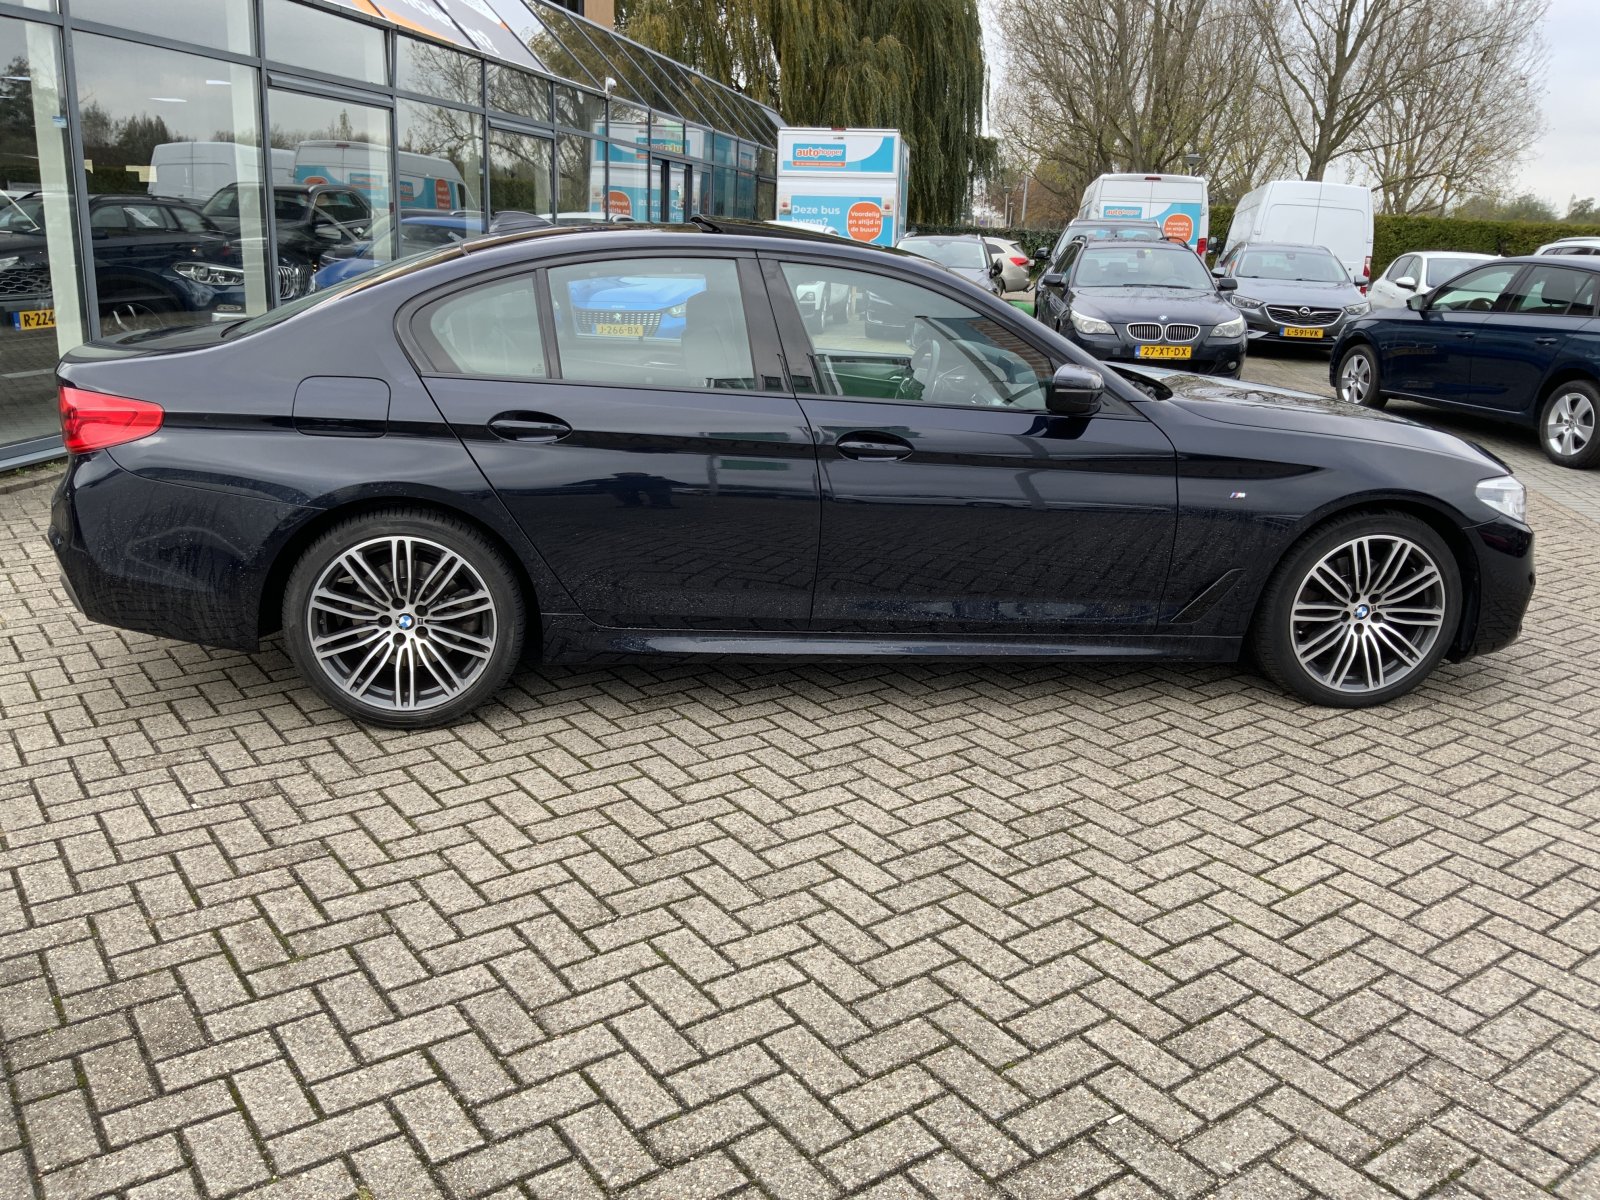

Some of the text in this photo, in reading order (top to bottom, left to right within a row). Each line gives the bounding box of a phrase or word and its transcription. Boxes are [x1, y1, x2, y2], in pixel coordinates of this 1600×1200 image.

[796, 147, 843, 158] autohopper
[792, 205, 840, 214] Deze bus
[23, 311, 55, 327] R-224
[600, 326, 639, 335] J-266-BX
[1287, 329, 1319, 337] L-591-VK
[1143, 346, 1187, 357] 27-XT-DX
